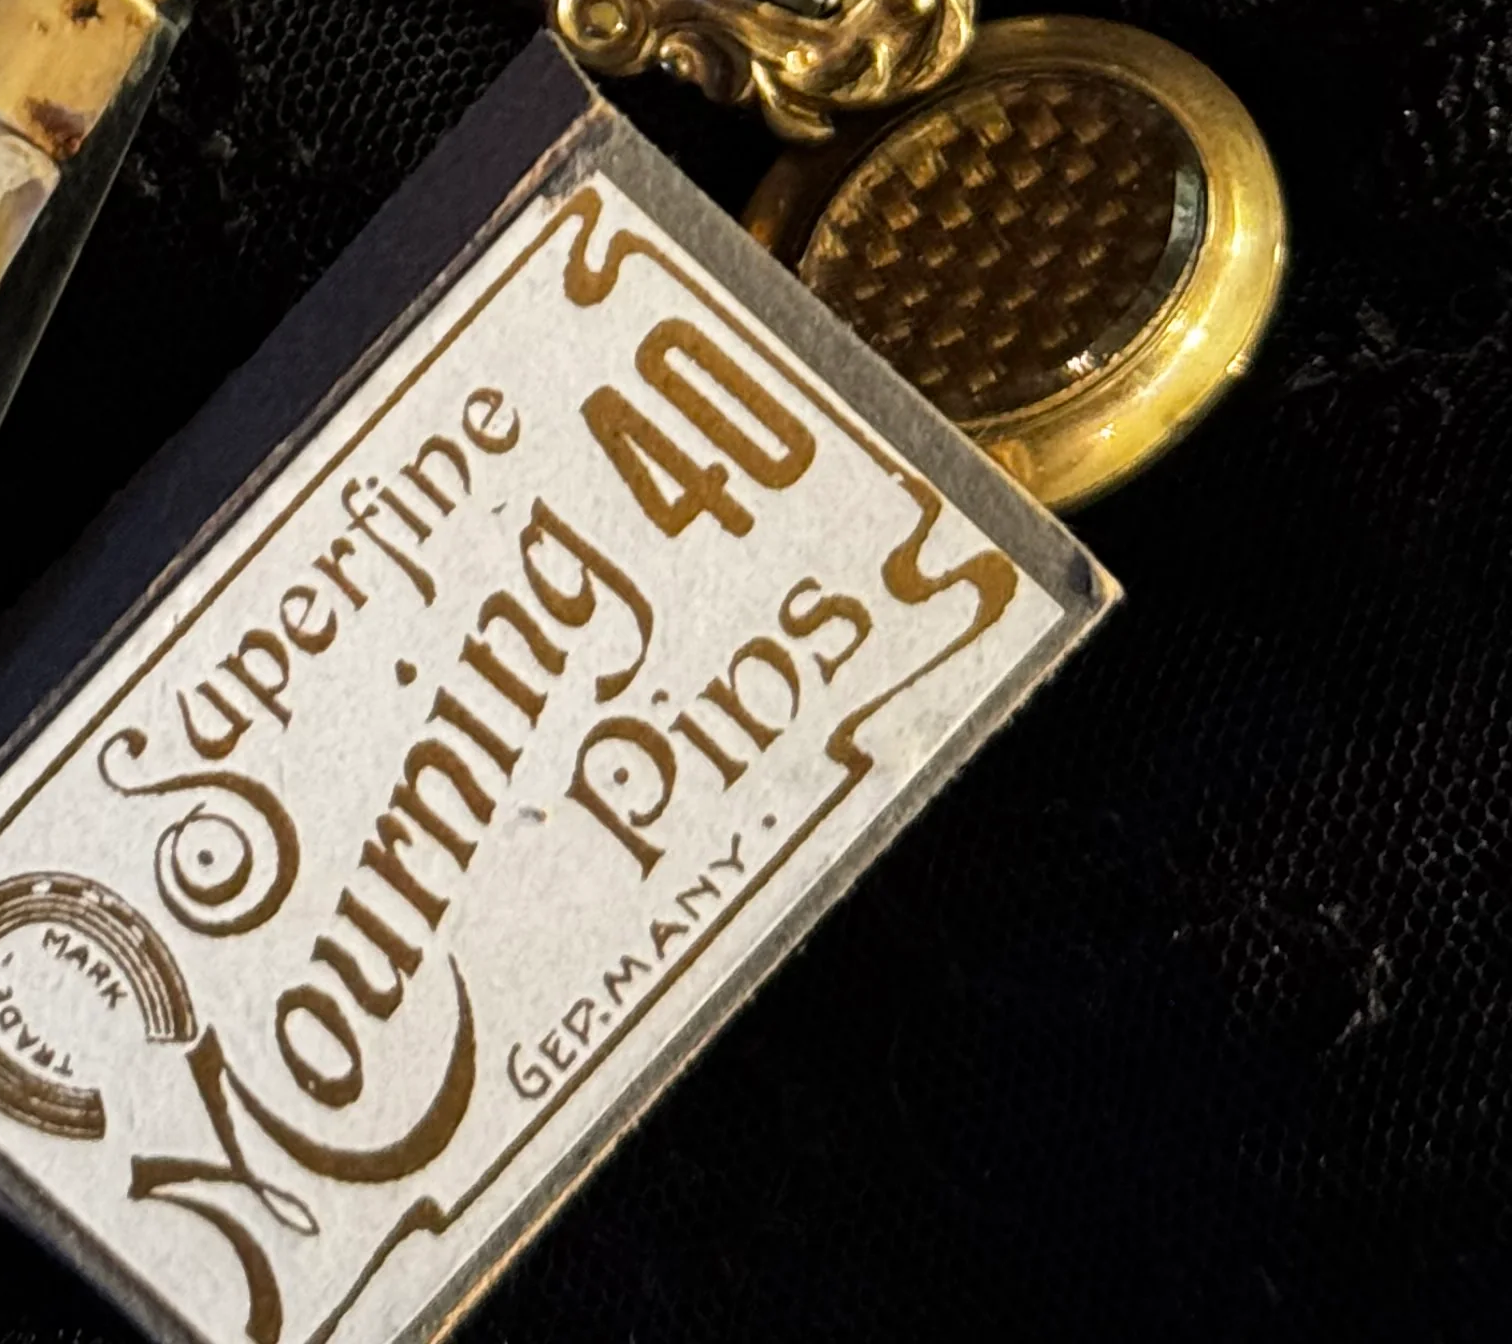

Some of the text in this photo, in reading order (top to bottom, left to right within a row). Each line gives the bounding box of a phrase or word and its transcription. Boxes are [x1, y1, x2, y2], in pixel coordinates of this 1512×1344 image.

[97, 386, 520, 939] Superfine
[126, 317, 817, 1344] Mourning 40
[41, 928, 127, 1009] MARK
